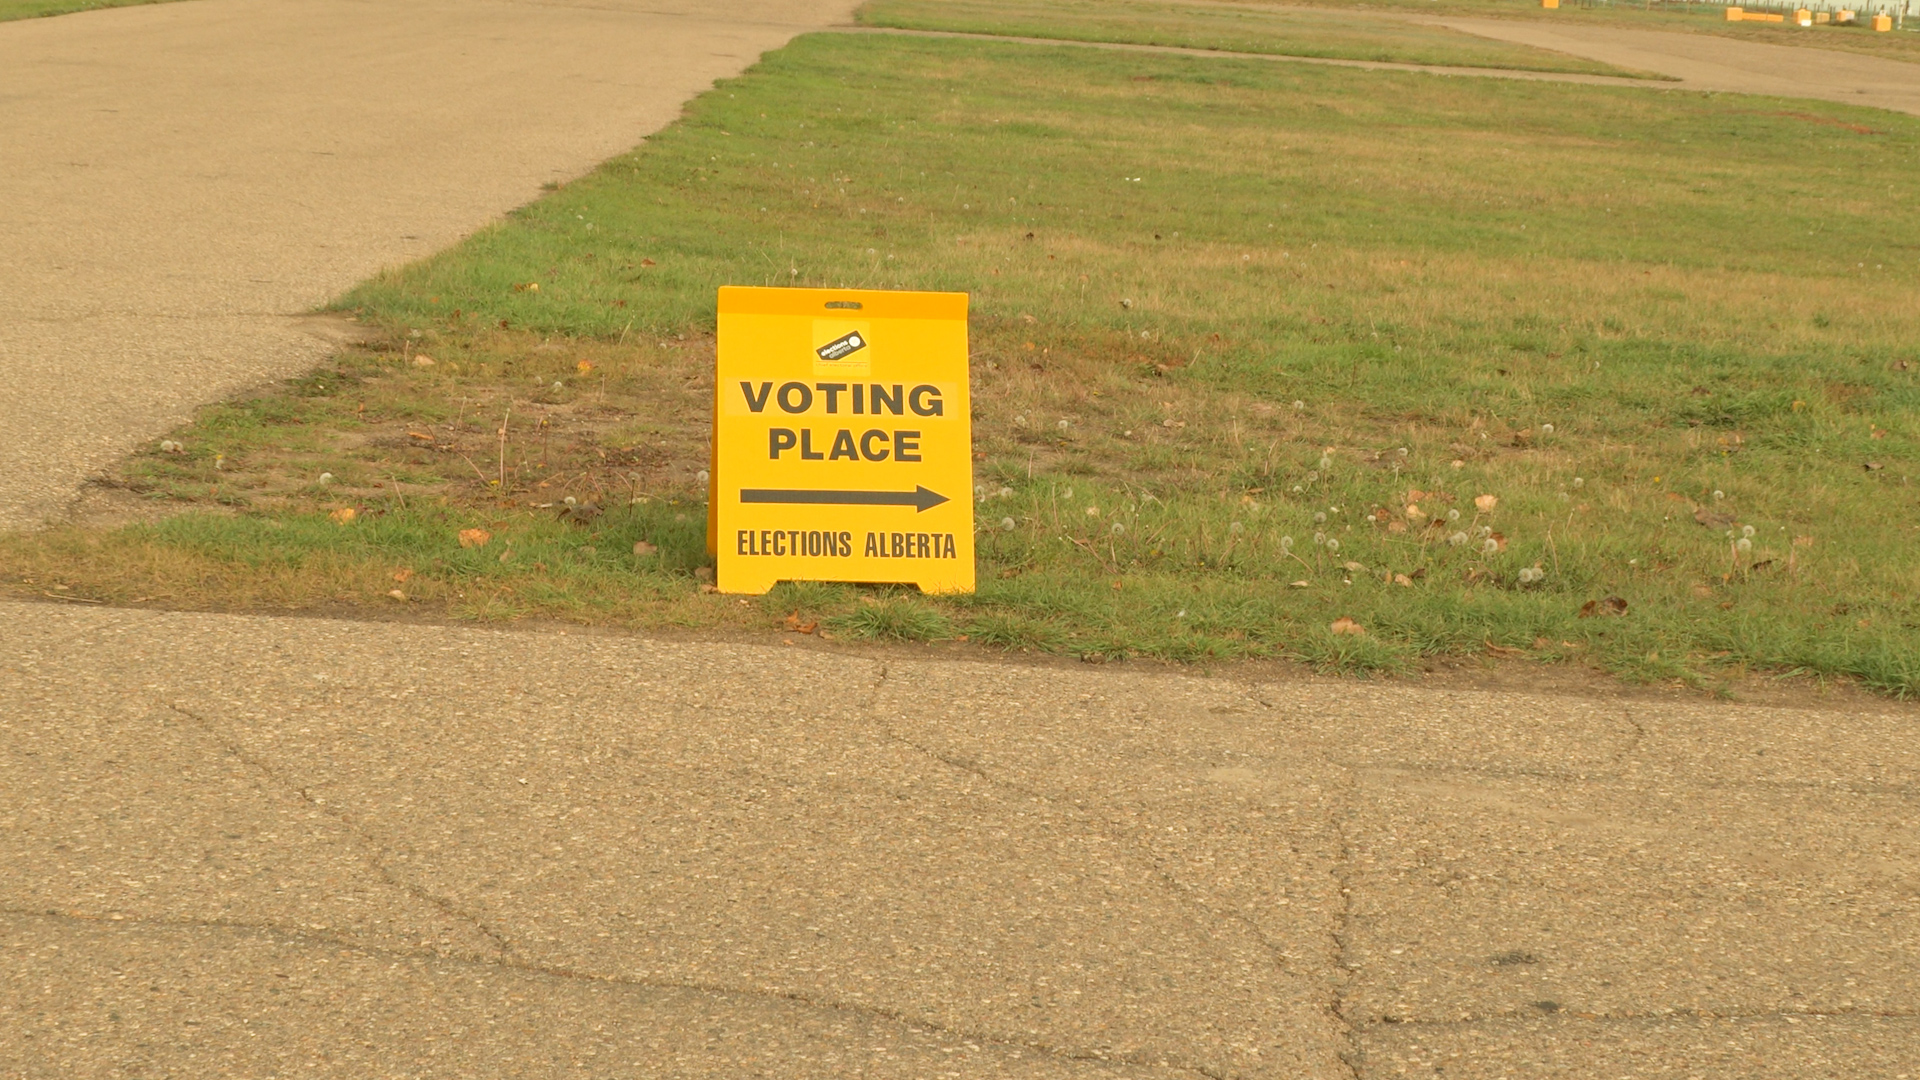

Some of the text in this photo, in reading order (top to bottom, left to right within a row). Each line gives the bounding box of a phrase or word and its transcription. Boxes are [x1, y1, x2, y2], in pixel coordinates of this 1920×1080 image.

[739, 381, 943, 417] VOTING
[769, 428, 922, 462] PLACE
[737, 530, 957, 559] ELECTIONS ALBERTA
